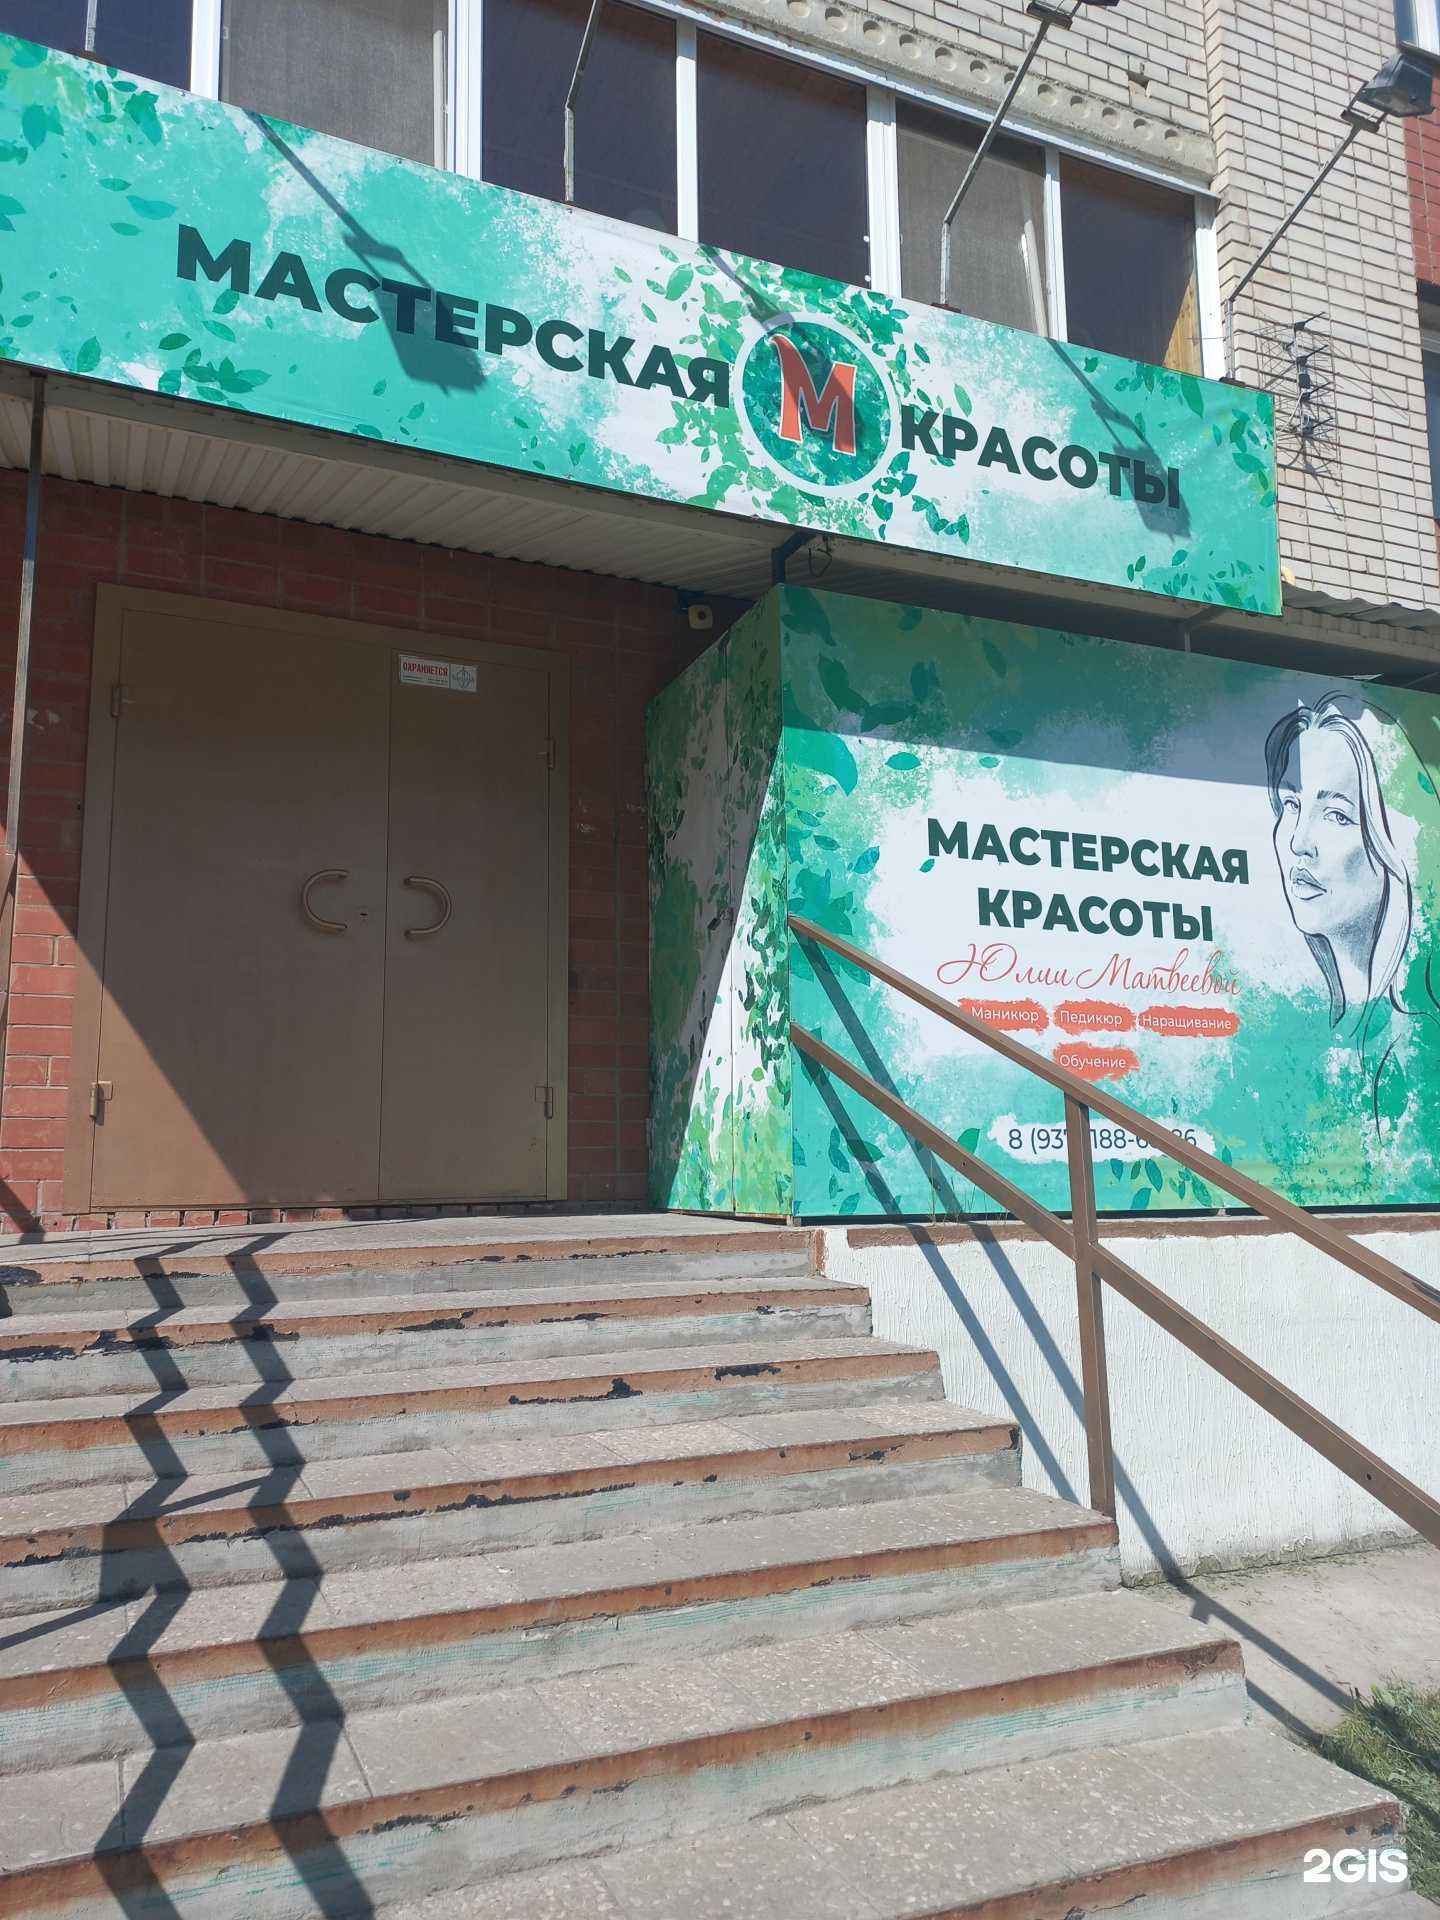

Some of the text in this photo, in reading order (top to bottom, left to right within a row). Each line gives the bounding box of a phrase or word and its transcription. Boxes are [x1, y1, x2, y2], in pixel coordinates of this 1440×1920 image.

[176, 223, 1181, 509] МАСТЕРСКАЯ КРАСОТЫ
[928, 818, 1249, 884] МАСТЕРСКАЯ
[978, 888, 1213, 941] КРАСОТЫ
[936, 942, 1242, 996] Юлии Матвеевой
[971, 1006, 1232, 1030] Маникюр Педикюр Наращивание
[1059, 1054, 1127, 1070] Обучение
[1008, 1128, 1023, 1150] 8
